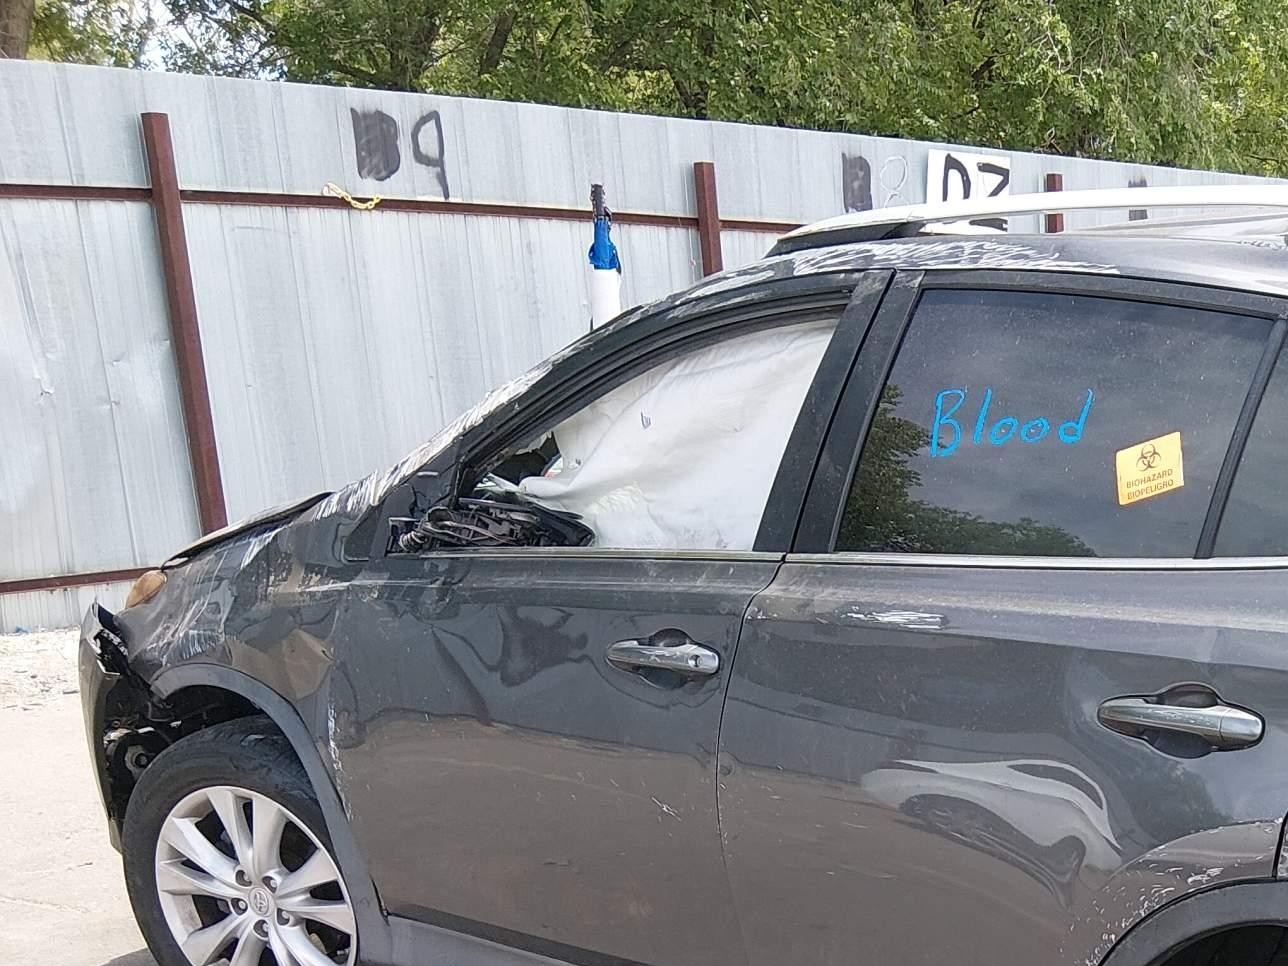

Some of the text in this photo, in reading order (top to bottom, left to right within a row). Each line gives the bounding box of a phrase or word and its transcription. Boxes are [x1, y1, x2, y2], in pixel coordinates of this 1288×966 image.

[929, 387, 1095, 458] Blood
[1126, 468, 1174, 489] BIOHAZARD
[1127, 479, 1174, 500] BIOPELIGRO
